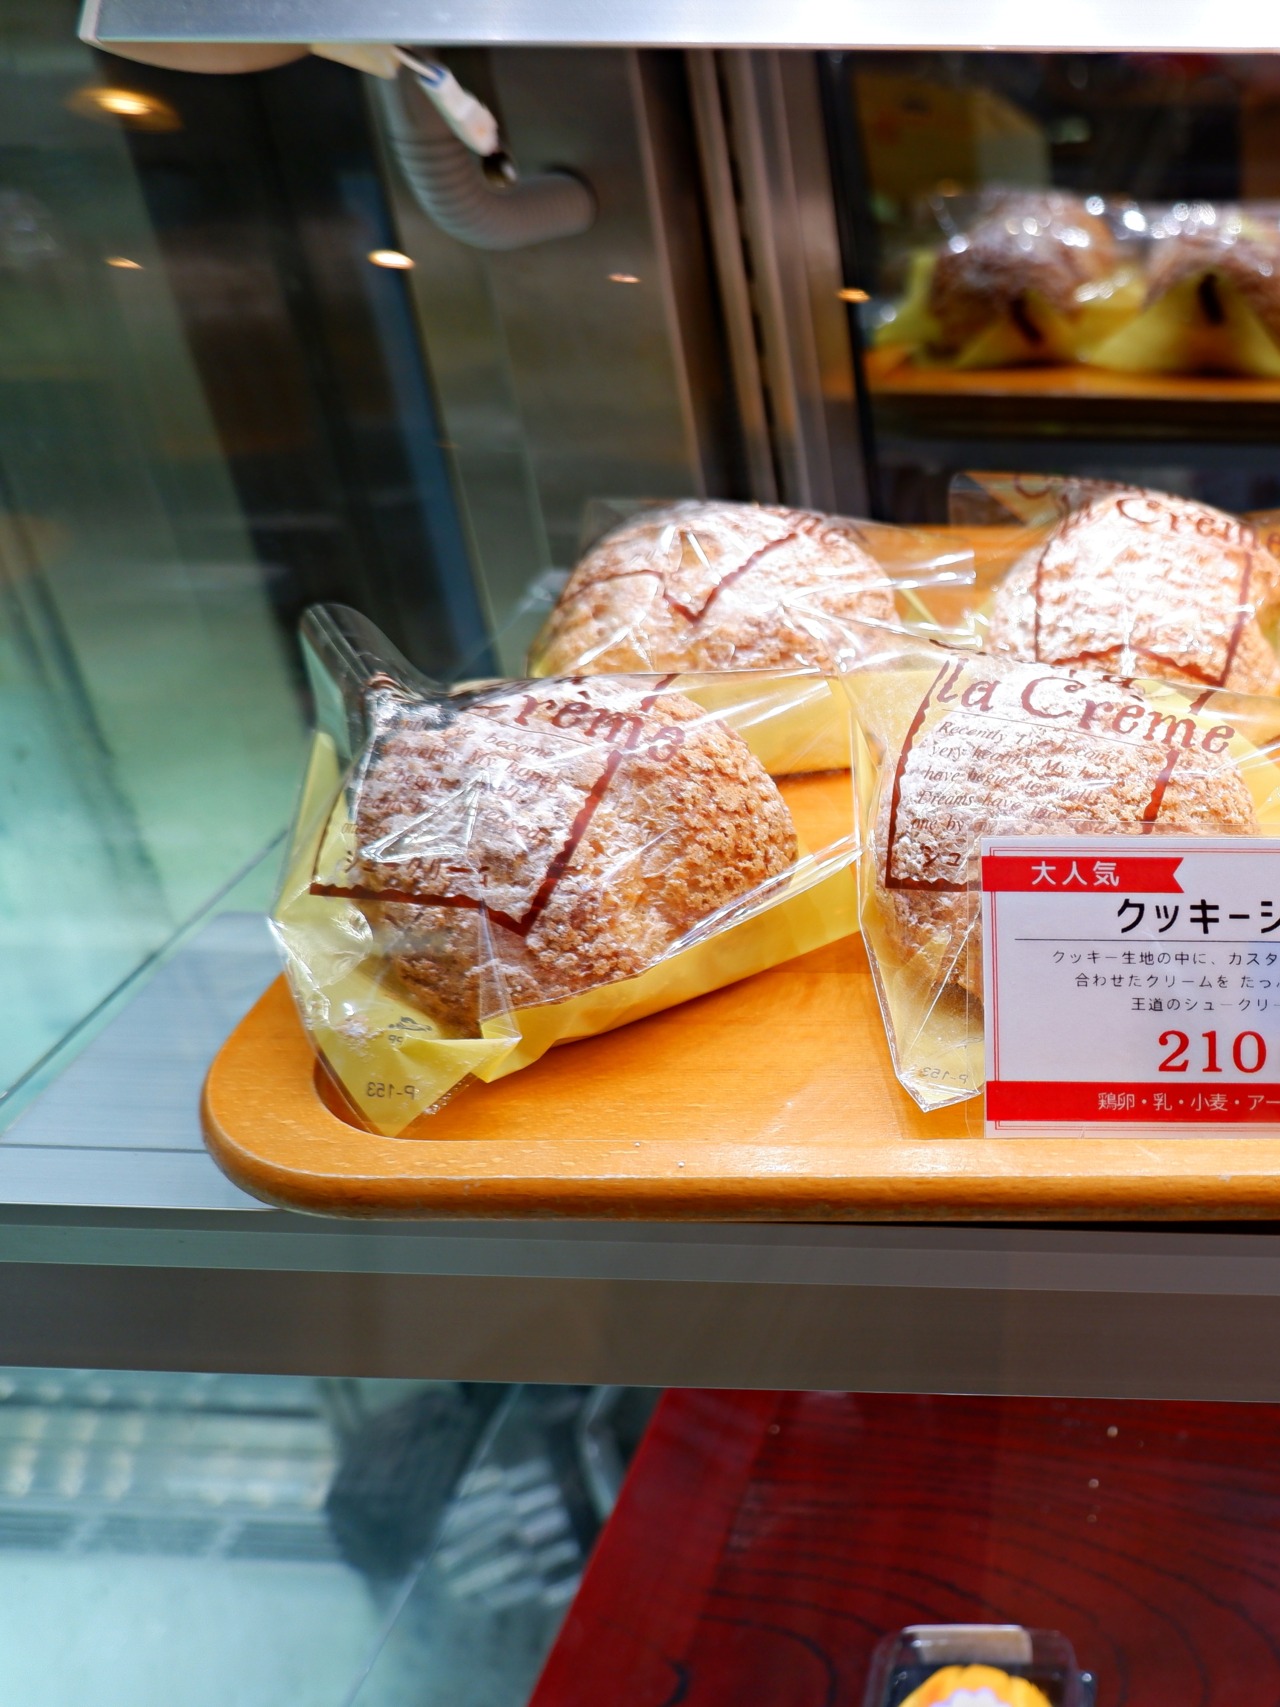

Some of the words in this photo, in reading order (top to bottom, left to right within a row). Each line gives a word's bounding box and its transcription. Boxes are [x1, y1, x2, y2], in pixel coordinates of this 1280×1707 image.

[937, 658, 1002, 712] la
[936, 720, 1008, 744] Recently
[923, 765, 961, 782] have
[917, 789, 975, 806] Dreams
[1031, 861, 1119, 886] 大人気
[1075, 973, 1229, 989] 合わせたクリームを
[1158, 1030, 1267, 1073] 210
